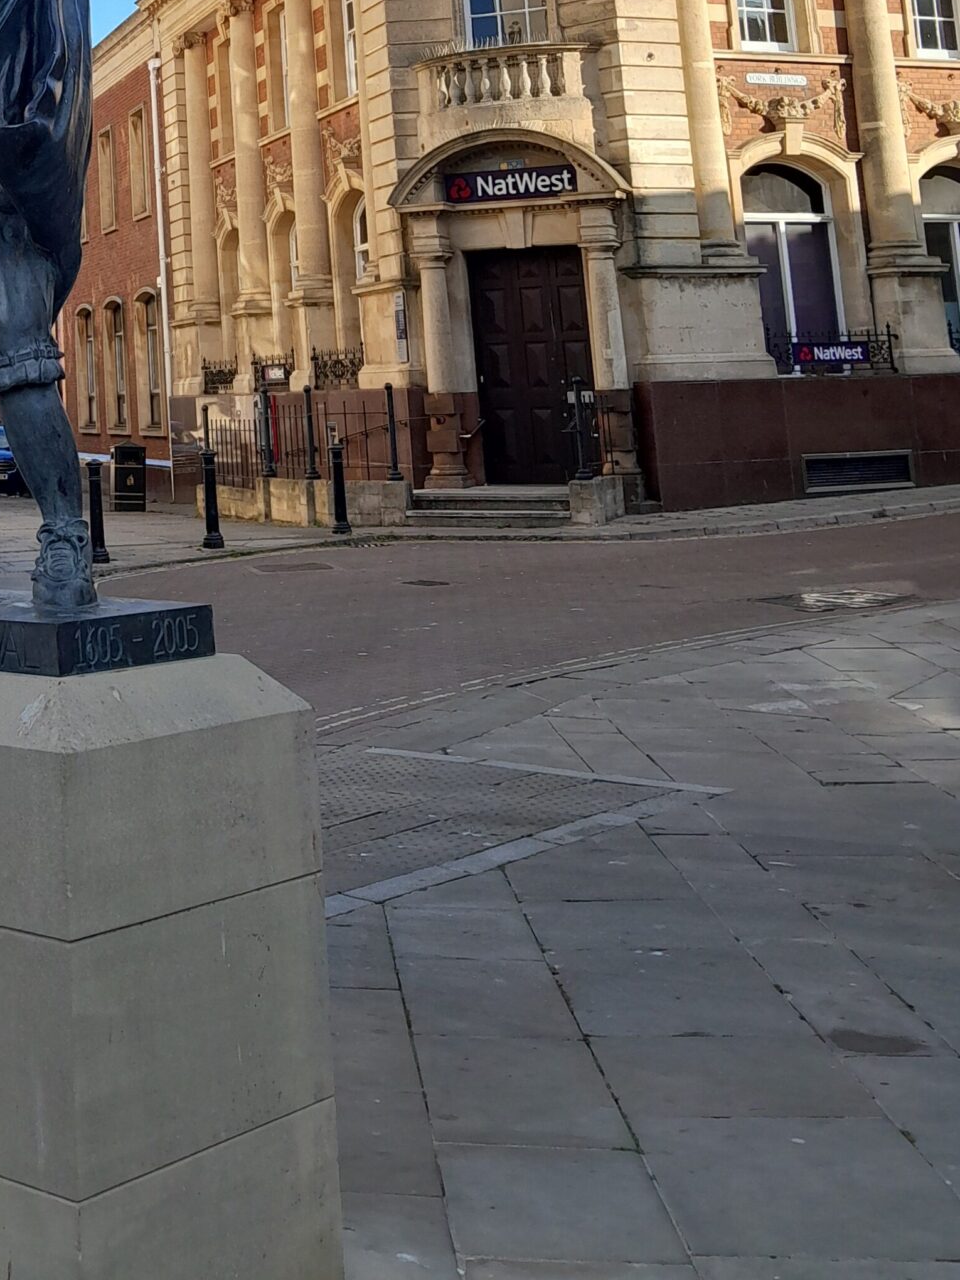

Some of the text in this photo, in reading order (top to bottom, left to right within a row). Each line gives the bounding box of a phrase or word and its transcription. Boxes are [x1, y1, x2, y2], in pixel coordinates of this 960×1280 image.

[476, 169, 573, 197] NatWest
[813, 345, 863, 360] NatWest
[152, 614, 199, 656] 2005
